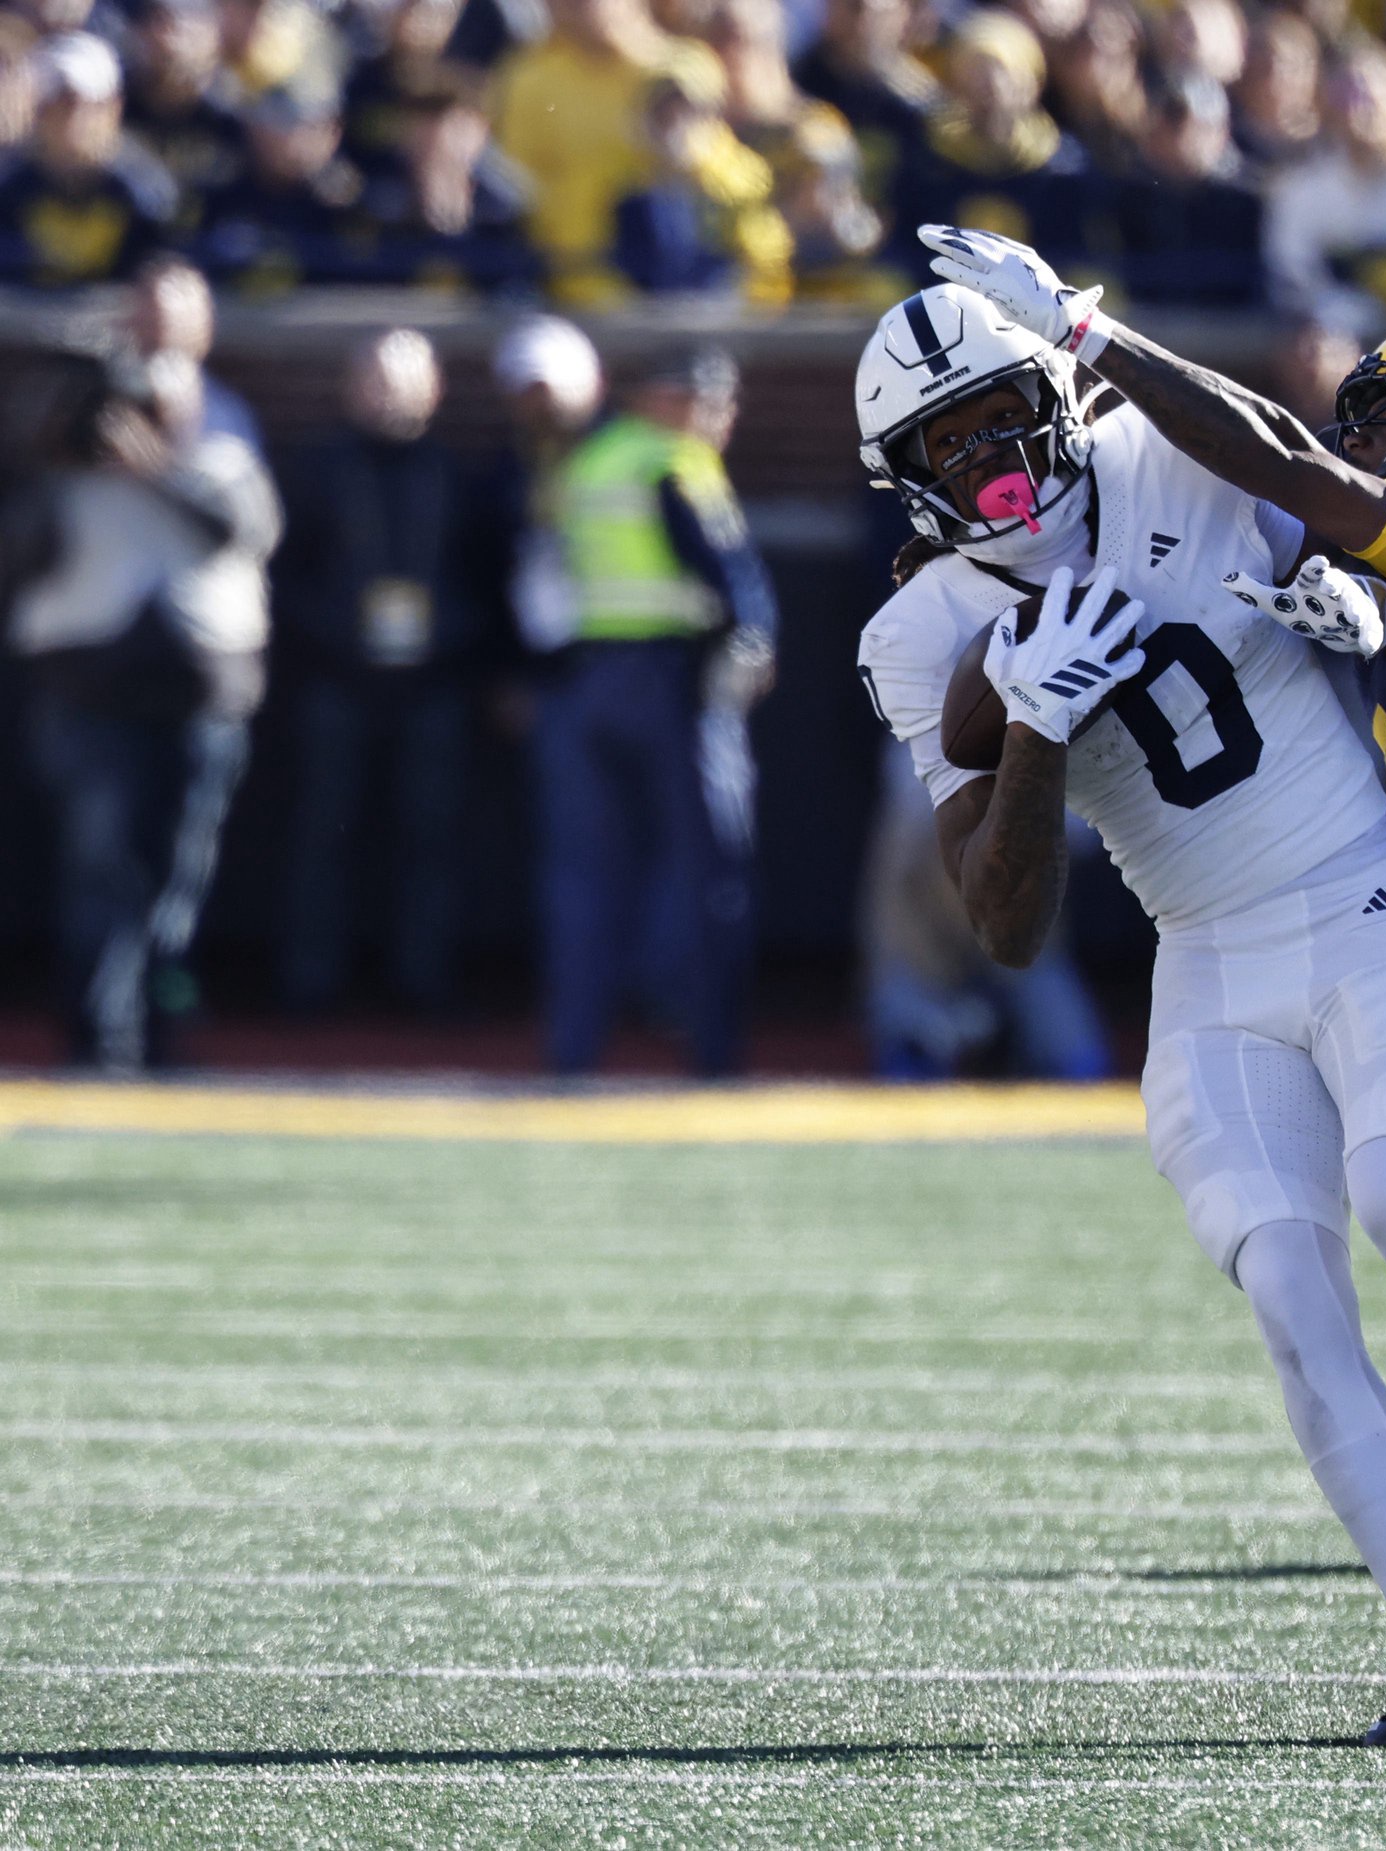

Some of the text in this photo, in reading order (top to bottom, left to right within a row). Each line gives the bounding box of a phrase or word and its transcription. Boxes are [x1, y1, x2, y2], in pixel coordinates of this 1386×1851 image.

[919, 365, 971, 397] PENN STATE
[1008, 685, 1042, 713] ADIZERO
[1112, 622, 1264, 810] 0
